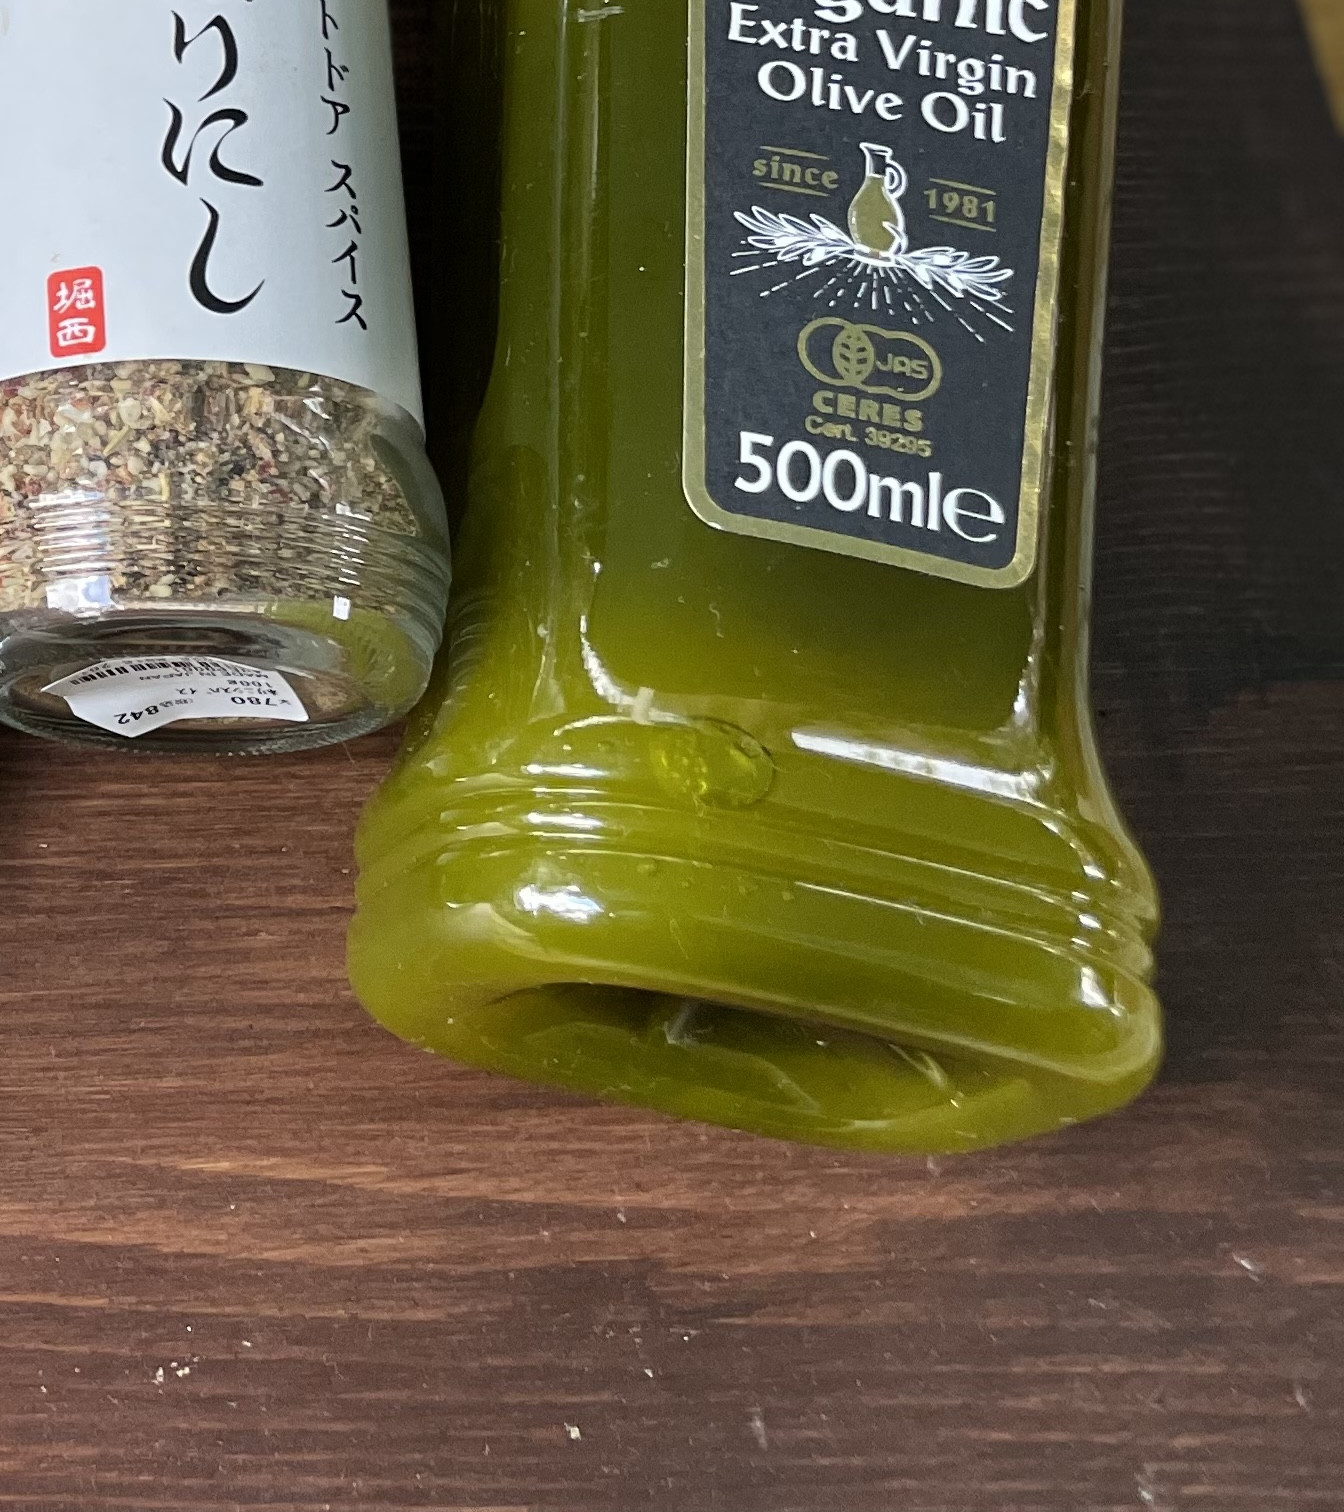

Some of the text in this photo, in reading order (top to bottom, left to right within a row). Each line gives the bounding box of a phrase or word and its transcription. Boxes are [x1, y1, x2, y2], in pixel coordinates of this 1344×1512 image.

[727, 1, 1037, 98] Extra Virgin
[757, 60, 1007, 144] Olive Oil
[752, 154, 997, 223] since 1981
[325, 159, 368, 332] スパイス
[53, 279, 97, 347] 堀西
[875, 356, 929, 380] JAS
[812, 390, 924, 432] CERES
